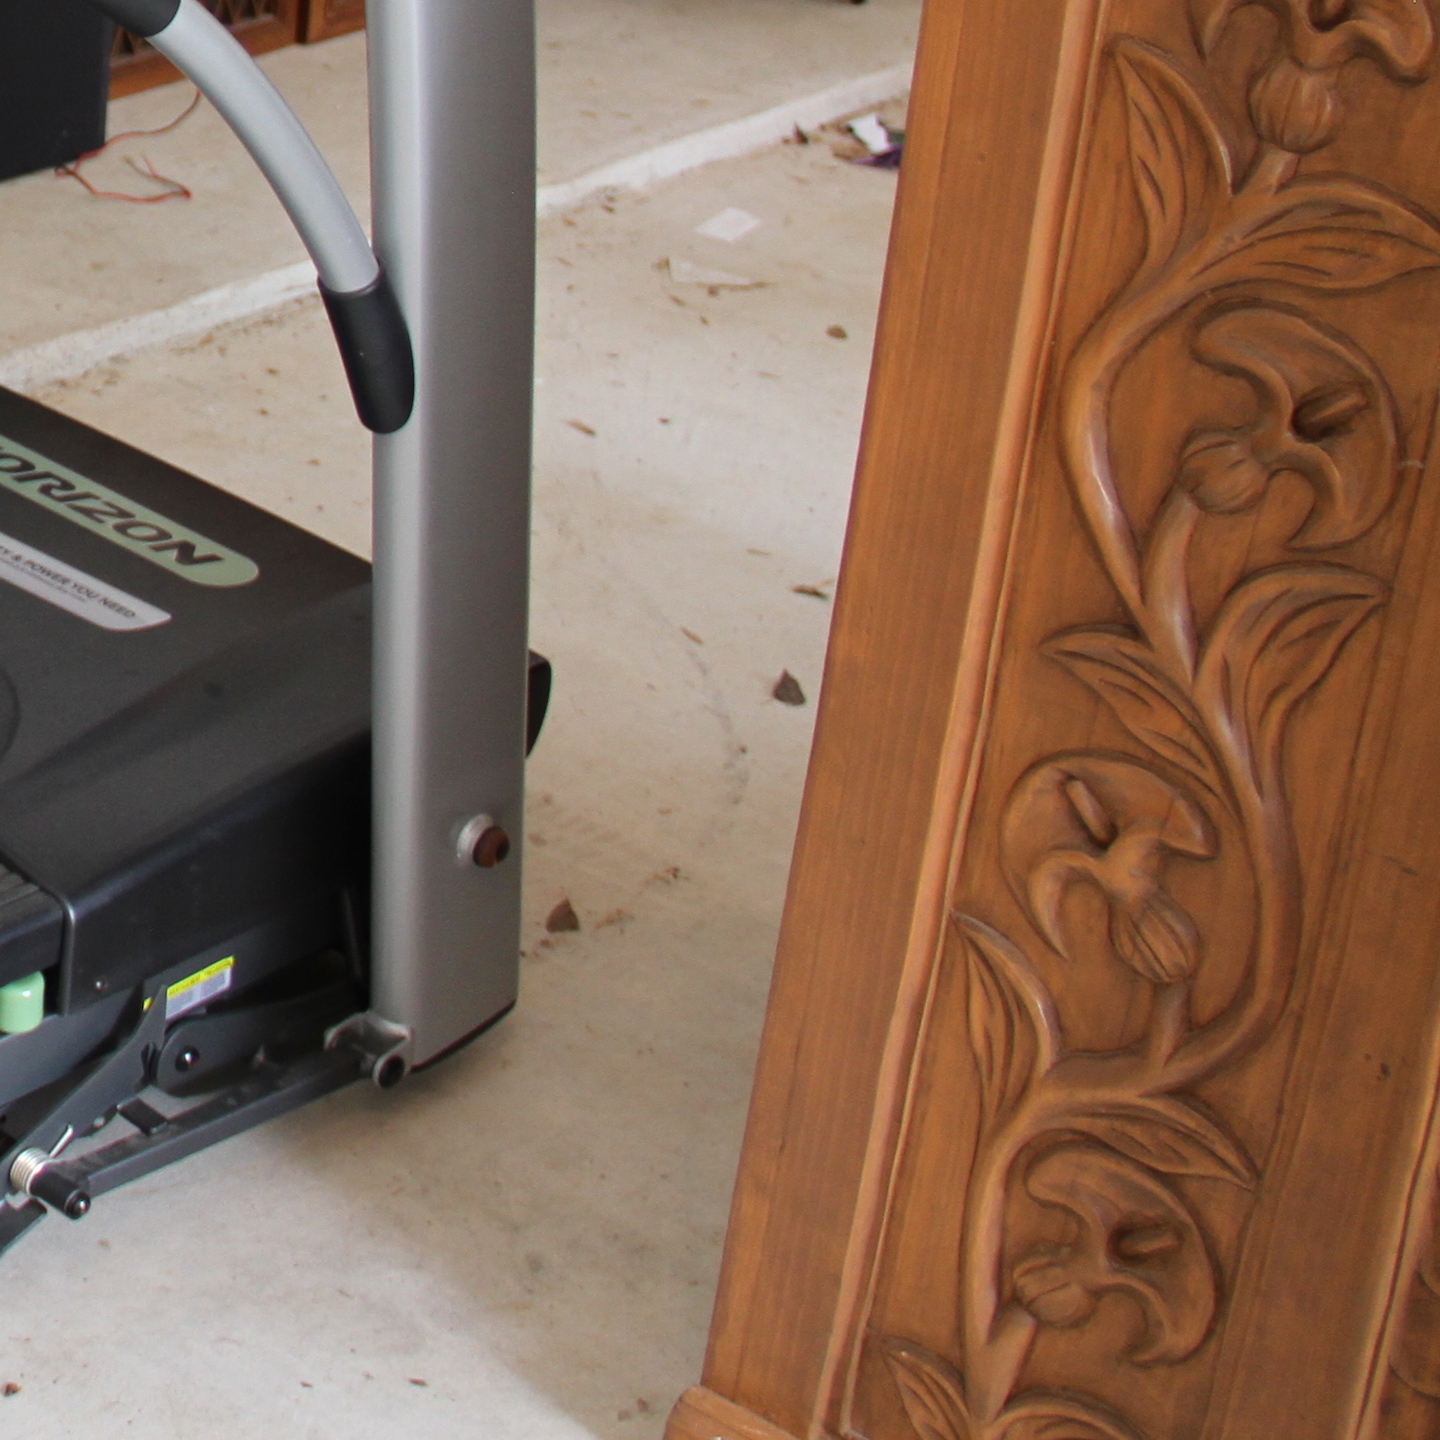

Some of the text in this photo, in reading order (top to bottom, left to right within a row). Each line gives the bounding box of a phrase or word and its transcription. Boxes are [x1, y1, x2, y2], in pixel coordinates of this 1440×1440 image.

[24, 559, 69, 585] POWER
[70, 580, 100, 600] YOU
[98, 596, 136, 619] NEED
